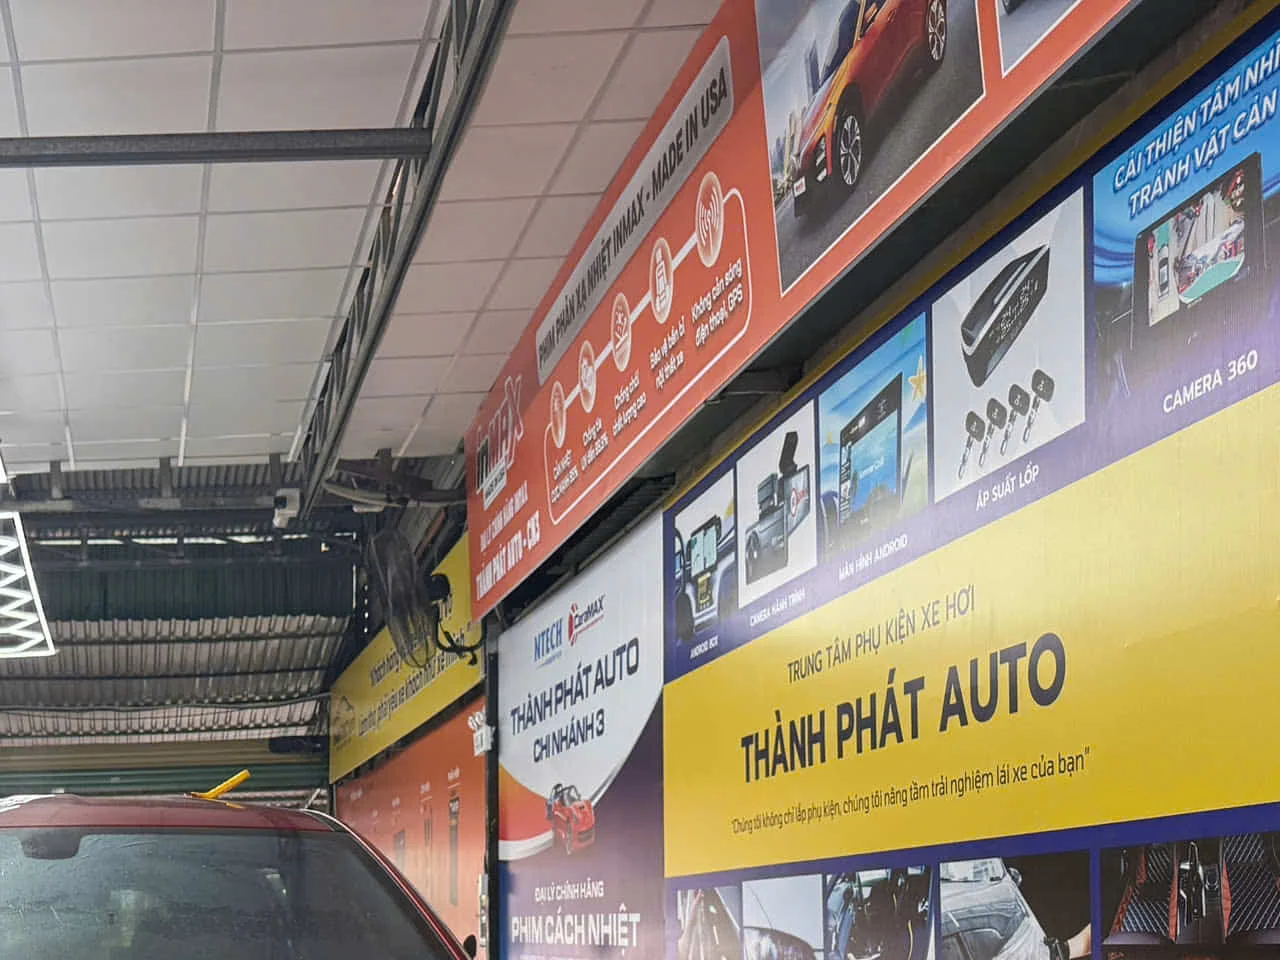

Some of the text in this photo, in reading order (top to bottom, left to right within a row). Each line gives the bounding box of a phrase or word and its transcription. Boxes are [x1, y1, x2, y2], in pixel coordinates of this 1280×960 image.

[1130, 88, 1278, 215] TRÁNH VẬT CẢN
[1146, 110, 1197, 165] THIỆN
[1200, 75, 1241, 124] TẦM
[538, 322, 556, 369] PHIM
[587, 238, 612, 296] NHIỆT
[613, 186, 645, 256] INMAX
[652, 128, 684, 200] MADE
[686, 107, 698, 152] IN
[701, 67, 728, 128] USA
[728, 283, 743, 312] GPS
[1162, 350, 1258, 413] CAMERA 360
[976, 460, 1040, 511] ÁP SUẤT LỐP
[873, 534, 909, 563] ANDROID
[787, 584, 975, 685] TRUNG TÂM PHỤ KIỆN XE HƠI
[511, 690, 553, 736] THÀNH
[555, 661, 592, 715] PHÁT
[593, 637, 639, 694] AUTO
[741, 632, 1067, 784] THÀNH PHÁT AUTO
[533, 708, 605, 763] CHI NHÁNH 3
[808, 805, 822, 825] phụ
[843, 795, 870, 815] chúng
[871, 790, 883, 809] tôi
[883, 787, 908, 808] nâng
[910, 779, 930, 800] tầm
[932, 775, 947, 798] trải
[951, 768, 994, 798] nghiệm
[996, 762, 1010, 787] lái
[1012, 763, 1028, 784] xe
[1031, 753, 1055, 779] của
[511, 902, 640, 957] PHIM CÁCH NHIỆT
